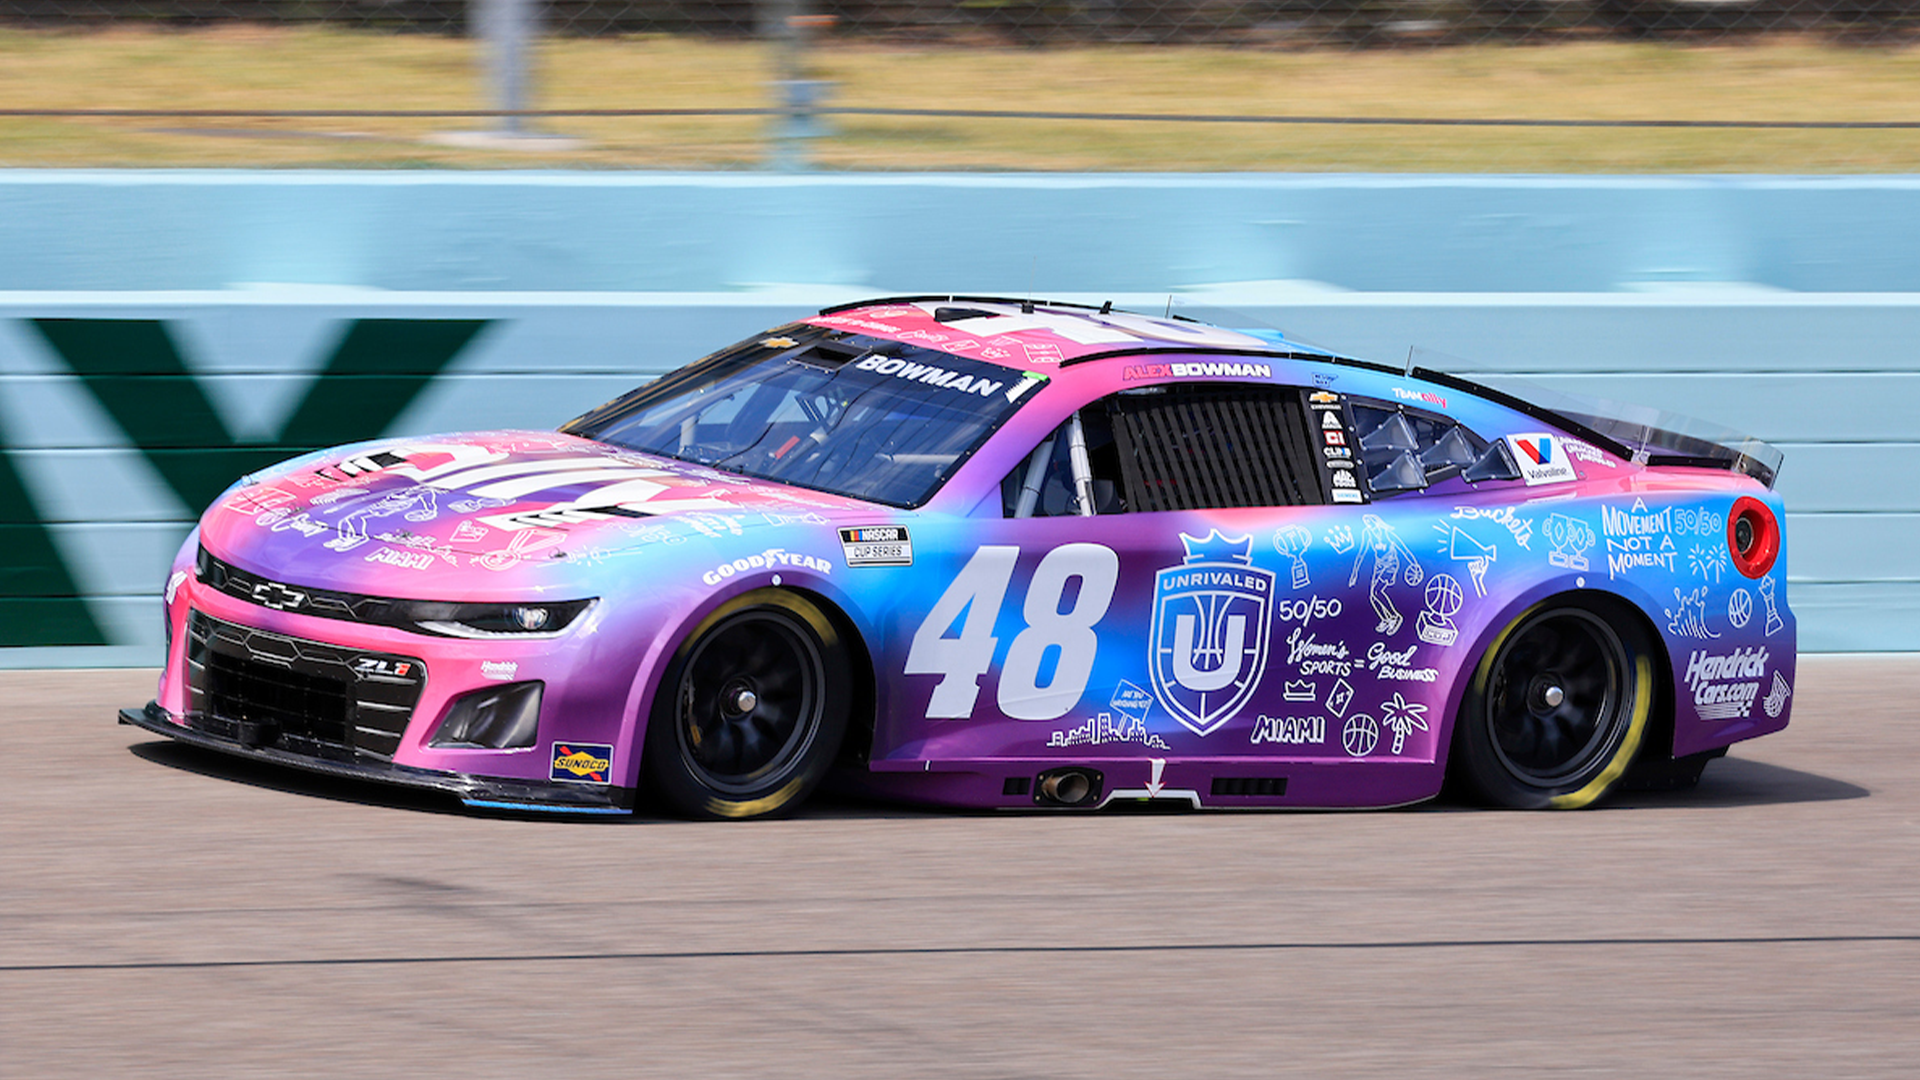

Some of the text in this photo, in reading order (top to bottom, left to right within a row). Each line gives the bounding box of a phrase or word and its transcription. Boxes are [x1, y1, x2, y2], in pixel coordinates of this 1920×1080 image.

[855, 354, 1003, 397] BOWMAN
[1527, 467, 1567, 479] Valvoline
[1631, 497, 1648, 513] A
[1450, 506, 1533, 551] Buckets
[1602, 503, 1673, 537] MOVEMENT
[1674, 506, 1722, 536] 50/50
[862, 529, 898, 541] NASCAR
[1606, 534, 1675, 552] NOT A
[854, 545, 902, 558] CUP SERIES
[1608, 552, 1678, 580] MOMENT
[1163, 572, 1267, 592] UNRIVALED
[1279, 595, 1342, 627] 50/50
[903, 542, 1120, 721] 48
[1172, 614, 1246, 691] U
[1286, 627, 1349, 665] Women's
[1367, 642, 1418, 670] Good
[1300, 659, 1352, 677] SPORTS
[1377, 665, 1439, 682] BUSINESS
[1684, 645, 1770, 691] Hendrick
[1694, 681, 1760, 706] Cars.com
[1250, 715, 1325, 744] MIAMI
[557, 758, 606, 769] SUNOCO
